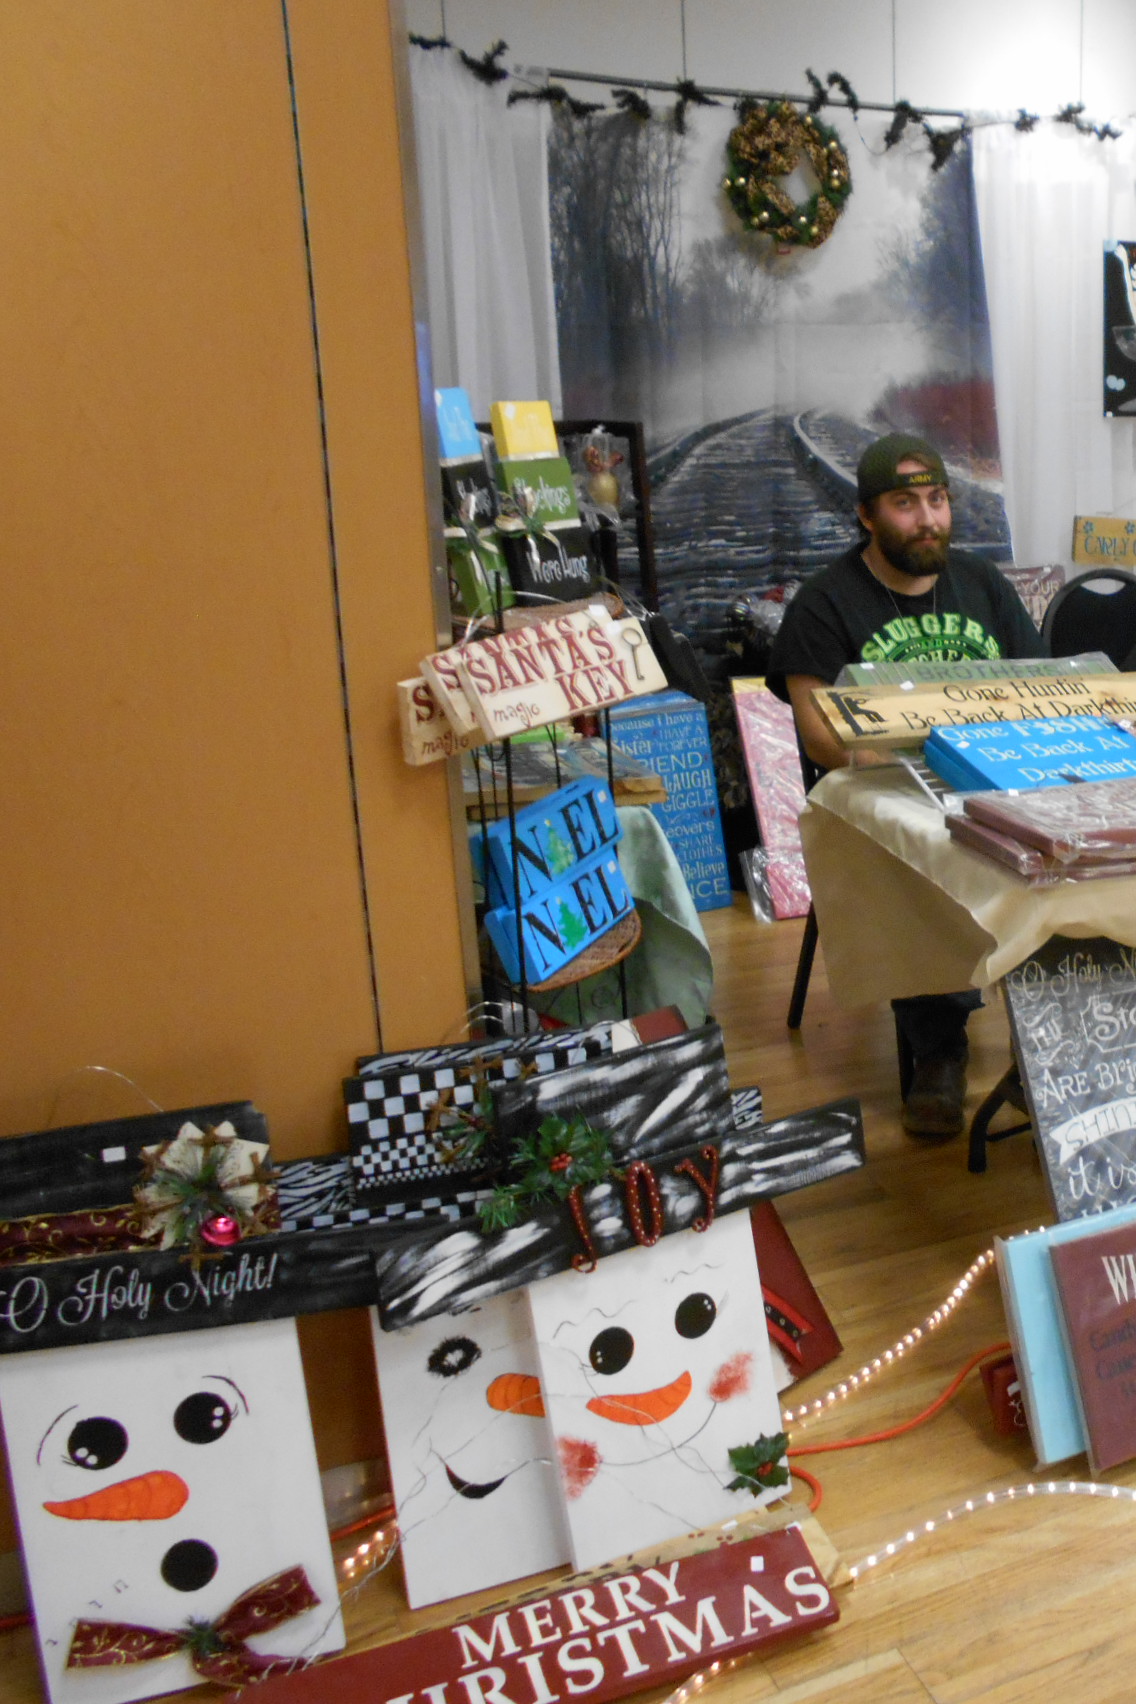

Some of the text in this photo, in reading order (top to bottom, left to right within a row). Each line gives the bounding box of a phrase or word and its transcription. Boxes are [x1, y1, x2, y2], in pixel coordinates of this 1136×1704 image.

[909, 474, 932, 484] ARMY
[861, 612, 1001, 664] SLUGGERS
[466, 626, 616, 695] SANTA'S
[916, 661, 1060, 682] BROTHERS
[556, 659, 635, 711] KEY
[943, 684, 1010, 703] Gone
[493, 703, 541, 730] magic
[664, 711, 693, 726] have
[900, 711, 941, 731] Be
[943, 705, 1007, 726] Back
[1018, 701, 1047, 720] At
[936, 724, 1010, 742] Gone
[639, 750, 704, 774] RIEND
[977, 734, 1132, 763] Be Back At
[664, 768, 713, 793] LAUGH
[661, 789, 716, 813] GIGGLE
[665, 819, 715, 837] eovers
[683, 860, 726, 879] Believe
[689, 877, 729, 900] NCE
[1050, 952, 1102, 1000] Holy
[1068, 1156, 1102, 1200] it
[566, 1144, 719, 1274] JOY
[0, 1252, 278, 1333] O Holy Night!
[452, 1561, 687, 1670] MERRY
[385, 1565, 832, 1704] RISTMAS
